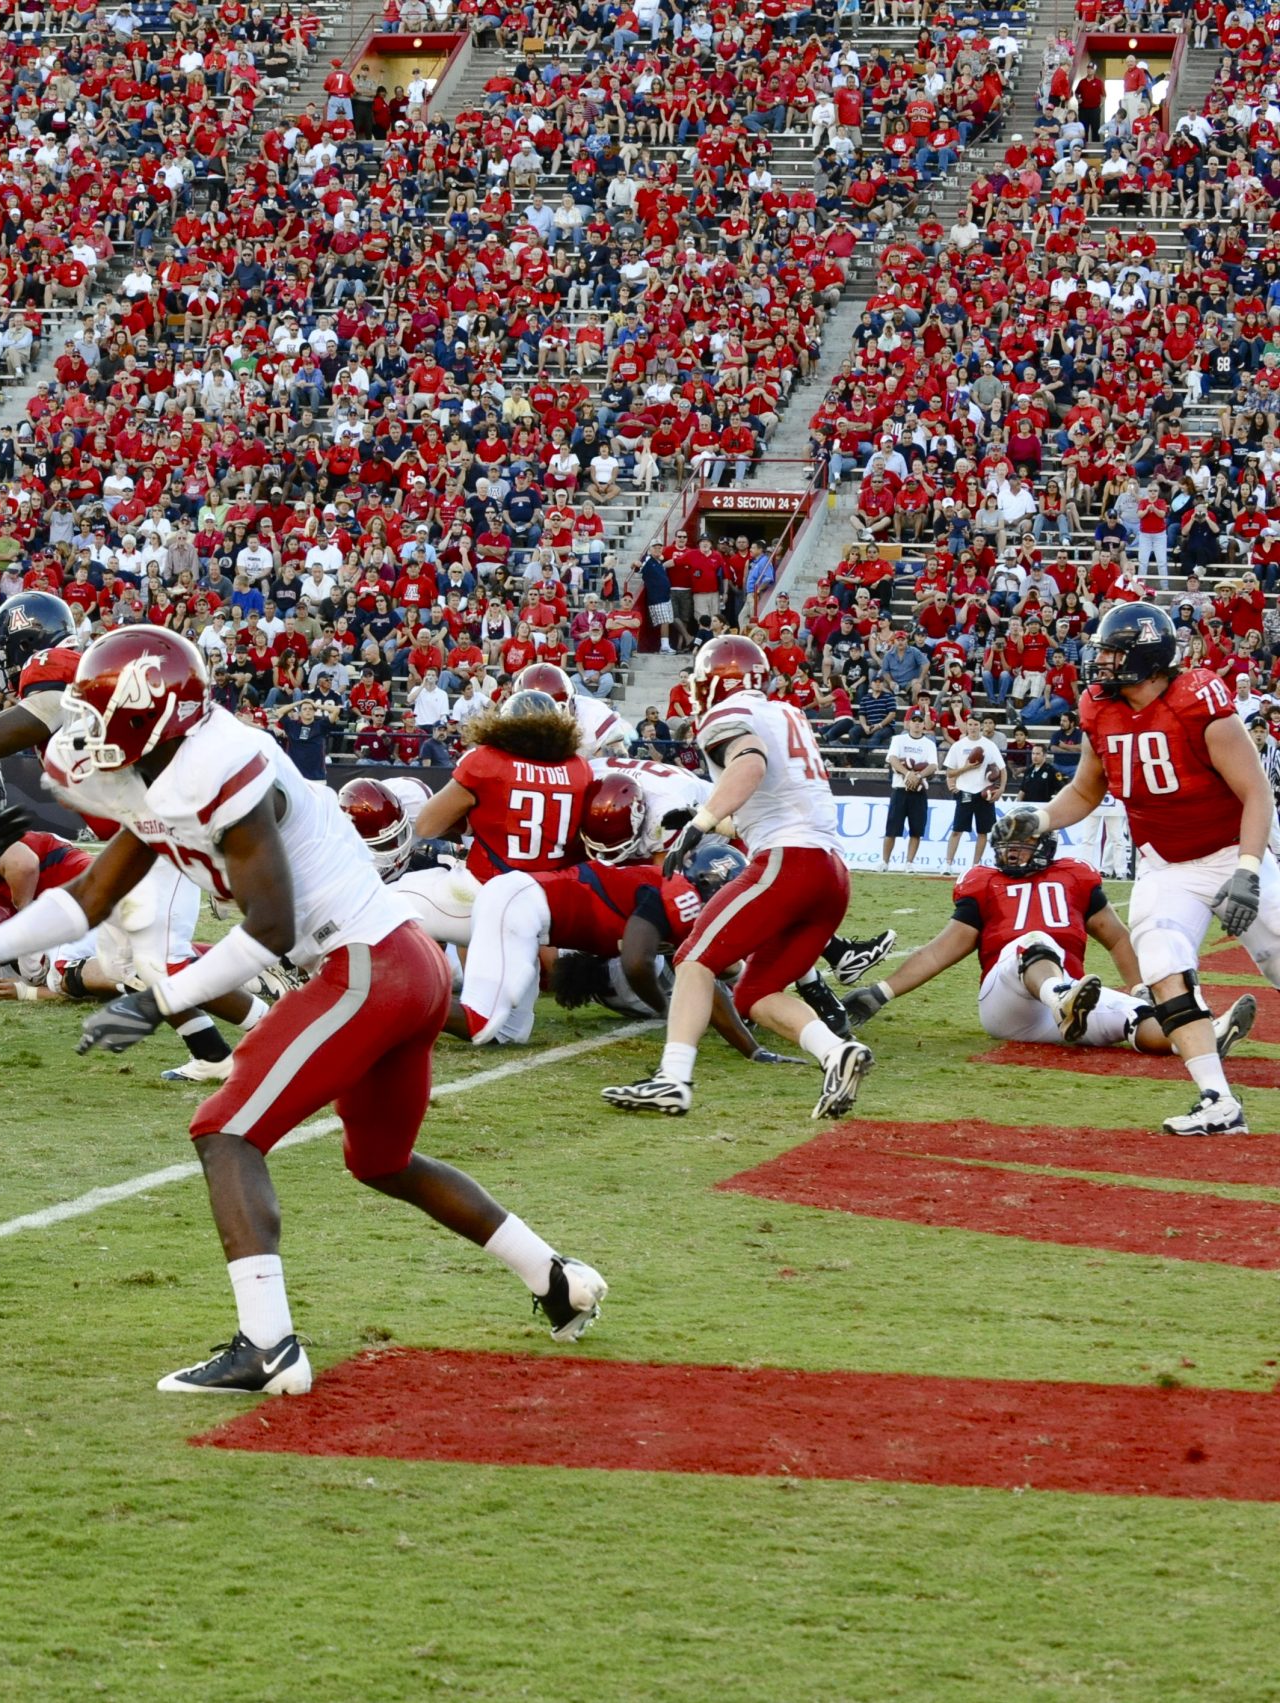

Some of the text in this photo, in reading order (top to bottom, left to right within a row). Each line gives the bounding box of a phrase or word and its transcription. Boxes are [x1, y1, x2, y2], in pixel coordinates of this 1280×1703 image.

[336, 74, 344, 90] 7
[1217, 356, 1231, 371] 68
[722, 496, 790, 510] 23 SECTION 24
[512, 760, 570, 786] TUTOGI
[1106, 731, 1180, 799] 78
[506, 789, 574, 861] 31
[1006, 881, 1070, 931] 70
[317, 926, 332, 939] 42
